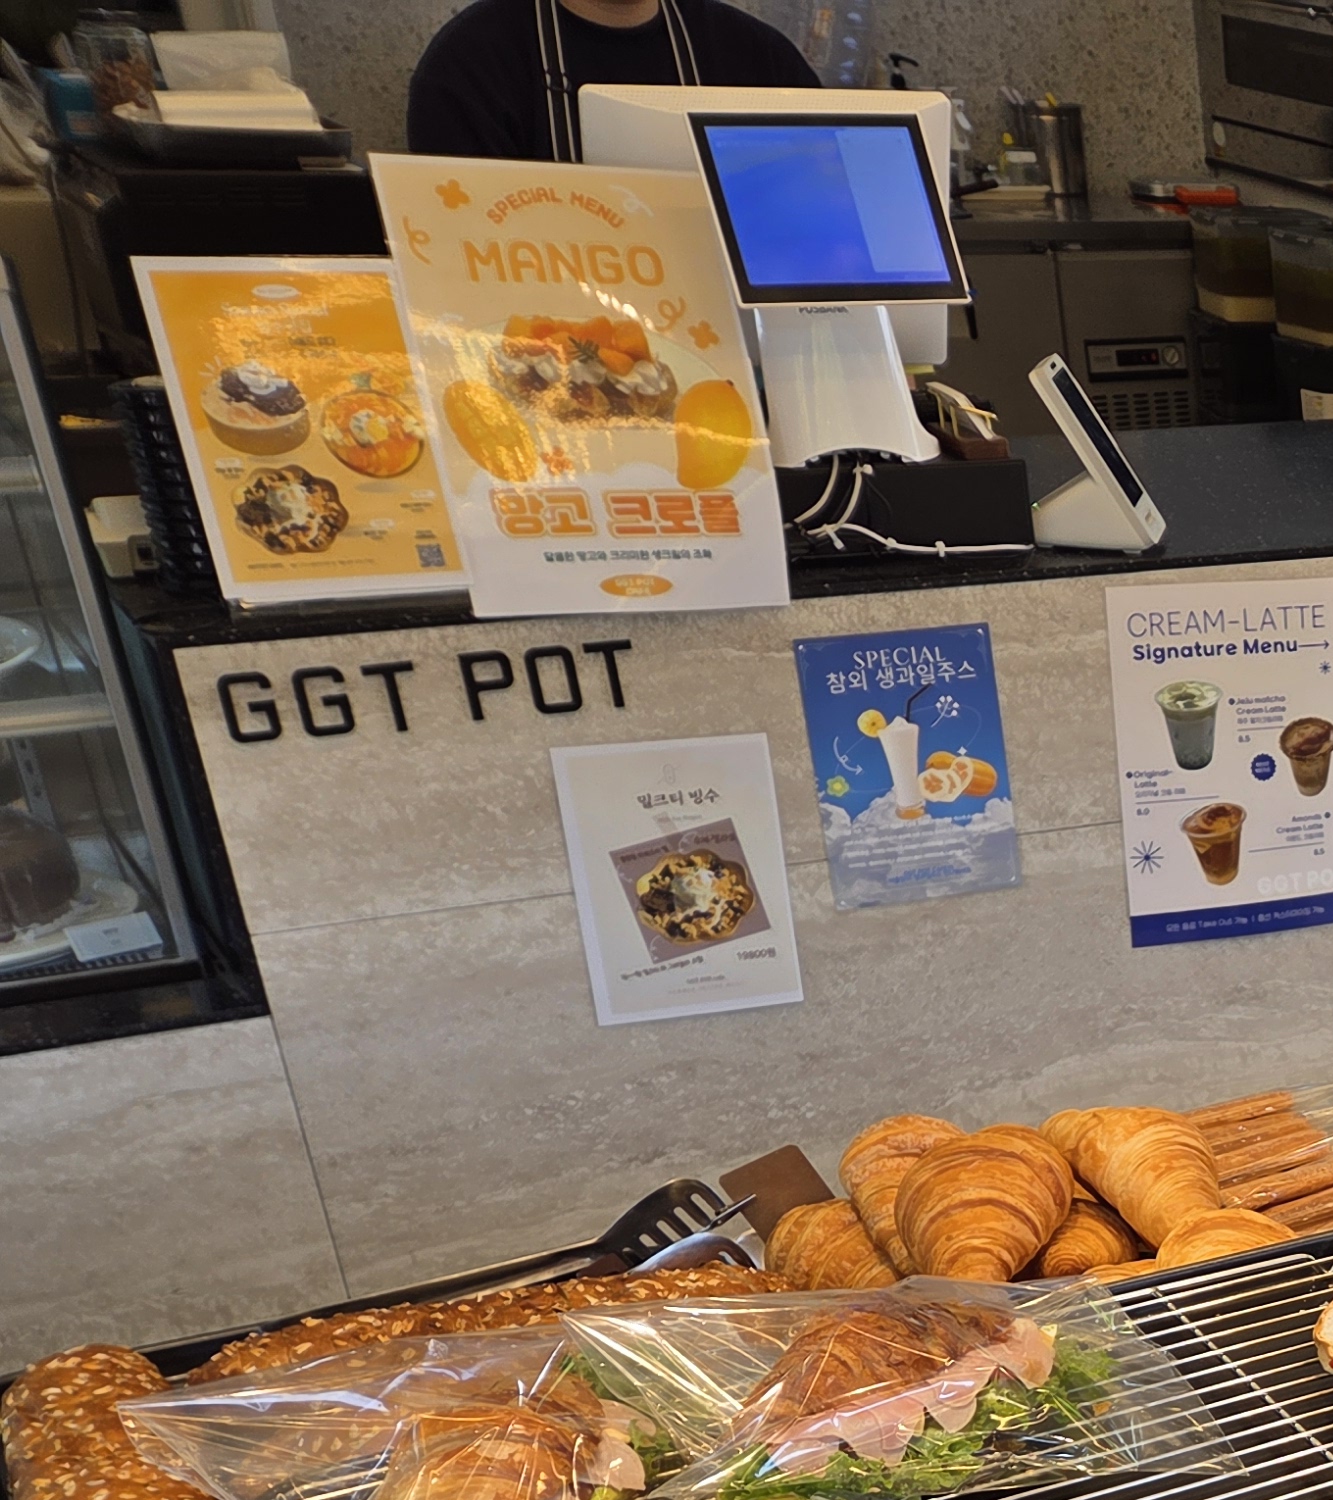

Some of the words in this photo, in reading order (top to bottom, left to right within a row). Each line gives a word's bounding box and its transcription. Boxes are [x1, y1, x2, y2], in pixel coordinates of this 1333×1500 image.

[486, 187, 564, 225] SPECIAL
[569, 190, 625, 229] MENU
[462, 240, 665, 287] MANGO
[489, 486, 598, 538] 망고
[603, 488, 742, 539] 크로플
[1126, 604, 1326, 638] CREAM-LATTE
[852, 645, 947, 670] SPECIAL
[1132, 642, 1238, 665] Signature
[1243, 638, 1298, 655] Menu
[216, 660, 414, 743] GGT
[457, 638, 632, 721] POT
[826, 669, 868, 695] 참외
[875, 660, 977, 688] 생과일주스
[636, 788, 686, 809] 밀크티
[688, 788, 721, 807] 빙수
